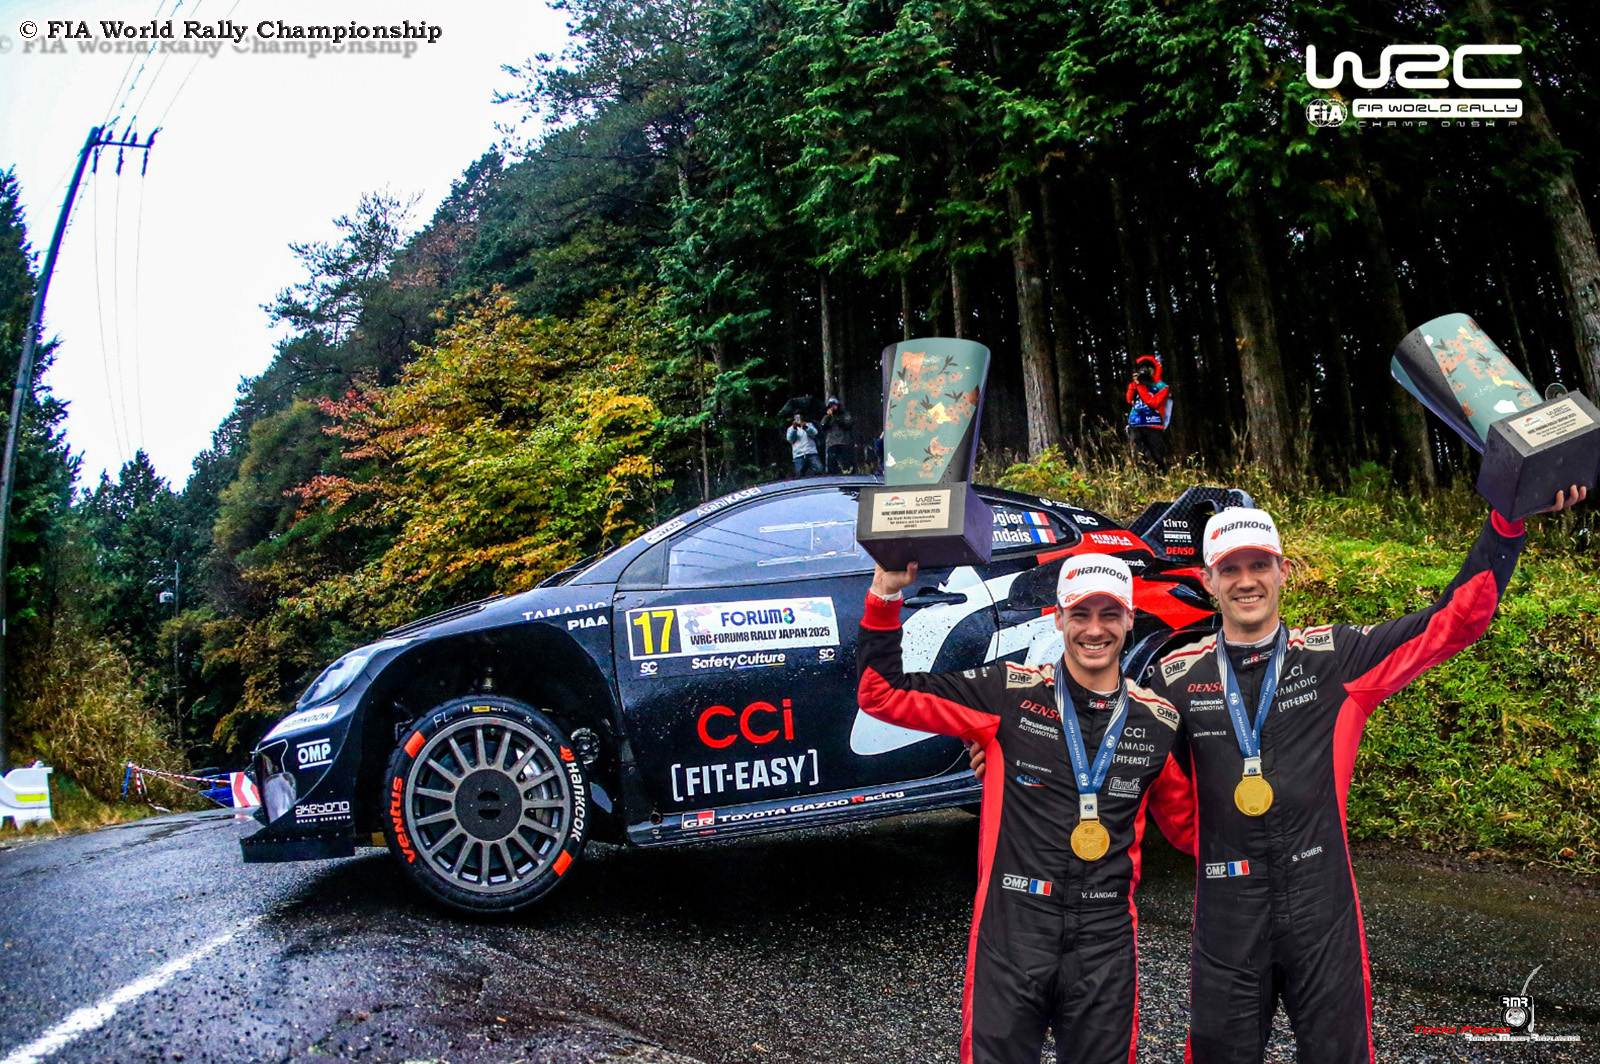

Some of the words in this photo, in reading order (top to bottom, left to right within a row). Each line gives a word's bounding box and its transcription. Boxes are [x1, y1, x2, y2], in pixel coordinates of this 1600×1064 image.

[992, 527, 1032, 542] ndais
[1166, 547, 1195, 556] DENSO
[522, 602, 607, 620] TAMADIC
[567, 615, 609, 630] PIAA
[633, 610, 674, 654] 17
[690, 635, 713, 646] WRC
[714, 632, 750, 645] FORUM8
[750, 629, 777, 642] RALLY
[778, 628, 808, 640] JAPAN
[808, 626, 830, 638] 2025
[1306, 635, 1330, 645] OMP
[818, 648, 835, 660] SC
[640, 661, 658, 674] SC
[691, 652, 786, 670] SafetyCulture
[1164, 661, 1186, 675] OMP
[1008, 673, 1033, 684] OMP
[1190, 698, 1224, 706] Panasonic
[1190, 704, 1225, 712] AUTOMOTIVE
[1157, 707, 1178, 722] OMP
[1020, 717, 1059, 734] Panasonic
[1018, 724, 1059, 741] AUTOMOTIVE
[1117, 741, 1155, 752] AMADIC
[297, 743, 332, 764] OMP
[683, 817, 714, 829] GR
[717, 807, 787, 823] TOYOTA
[789, 799, 850, 814] GAZOO
[1300, 846, 1323, 859] OGIER
[1205, 865, 1226, 876] OMP
[1003, 876, 1029, 889] OMP
[1089, 891, 1118, 899] LANDAIS
